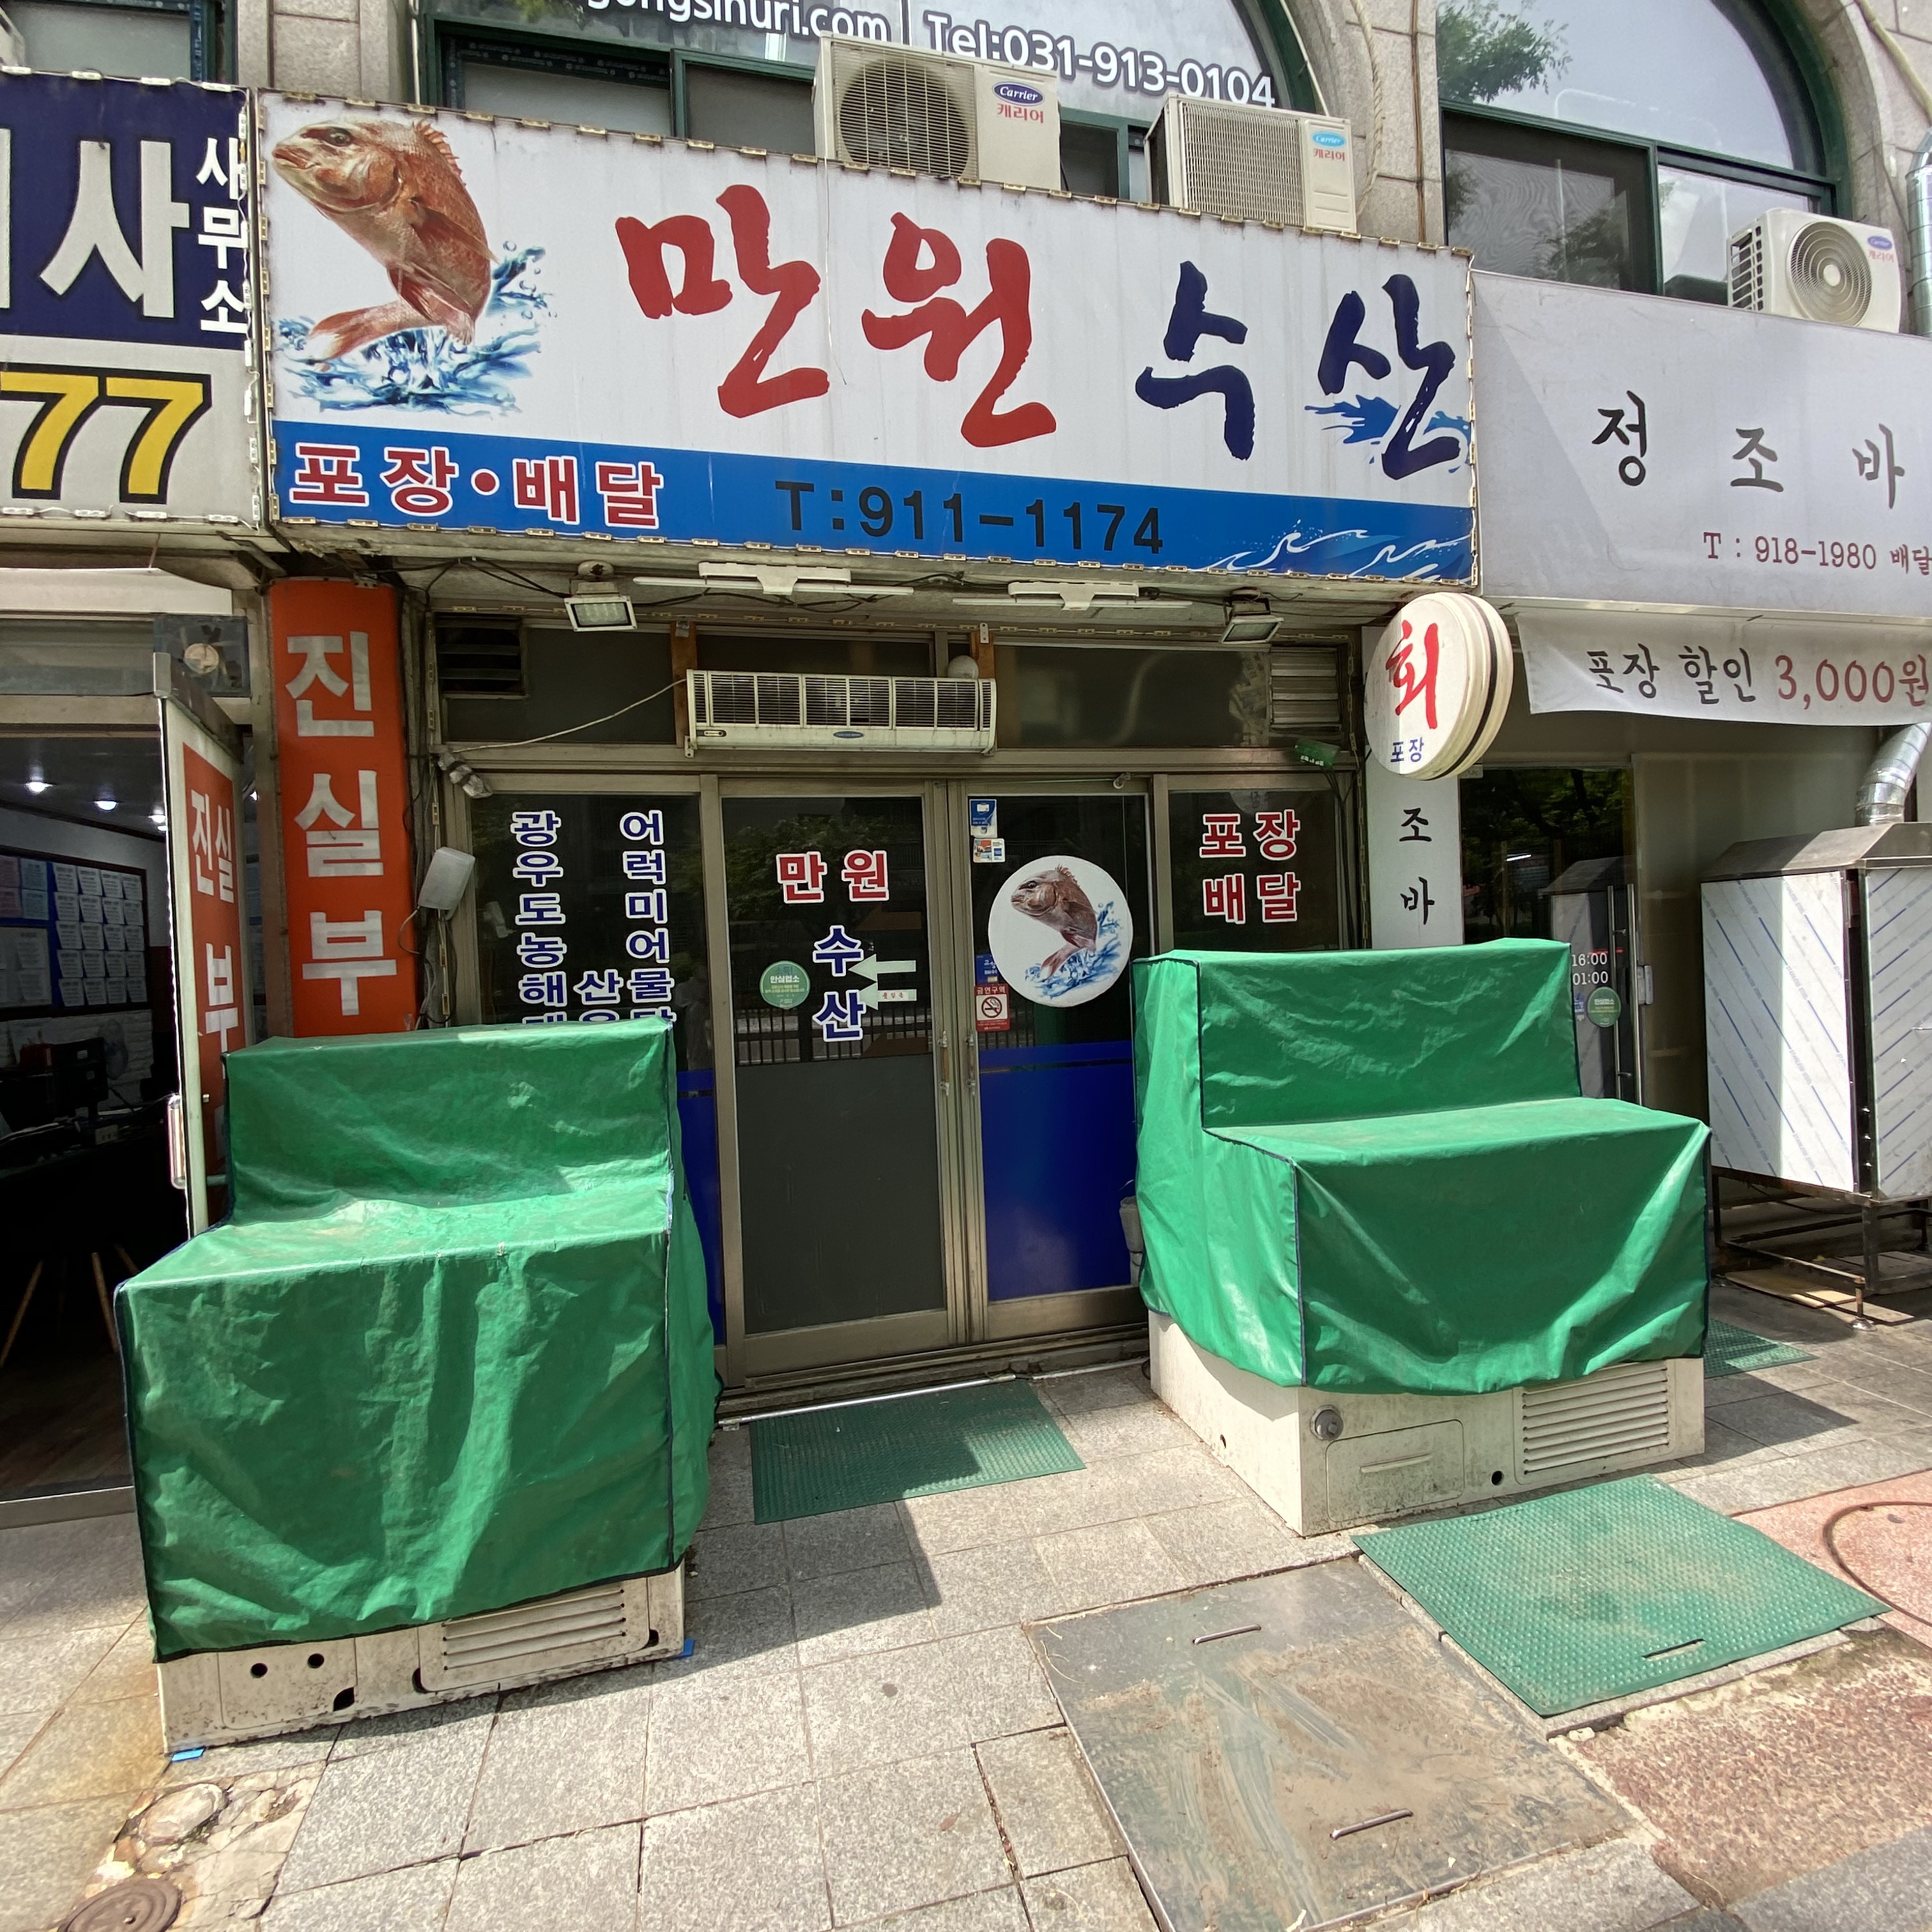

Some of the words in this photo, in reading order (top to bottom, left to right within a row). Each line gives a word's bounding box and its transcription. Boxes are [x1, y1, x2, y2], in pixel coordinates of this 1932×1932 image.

[997, 103, 1044, 123] 캐리어
[999, 86, 1038, 101] Carrier
[1314, 148, 1346, 162] 캐리어
[615, 184, 1057, 448] 만원
[1135, 261, 1456, 480] 수산
[1385, 619, 1439, 730] 회
[1587, 643, 1660, 699] 포장
[1678, 645, 1757, 705] 할인
[1775, 654, 1929, 710] 3,000원
[1390, 737, 1425, 763] 포장
[1199, 809, 1300, 861] 포장
[776, 850, 890, 904] 만원
[1202, 872, 1301, 924] 배달
[1572, 952, 1607, 967] 16:00
[1572, 970, 1609, 985] 01:00
[518, 967, 675, 1008] 해산물
[812, 924, 866, 1043] 수산
[977, 986, 1005, 995] 금연구역
